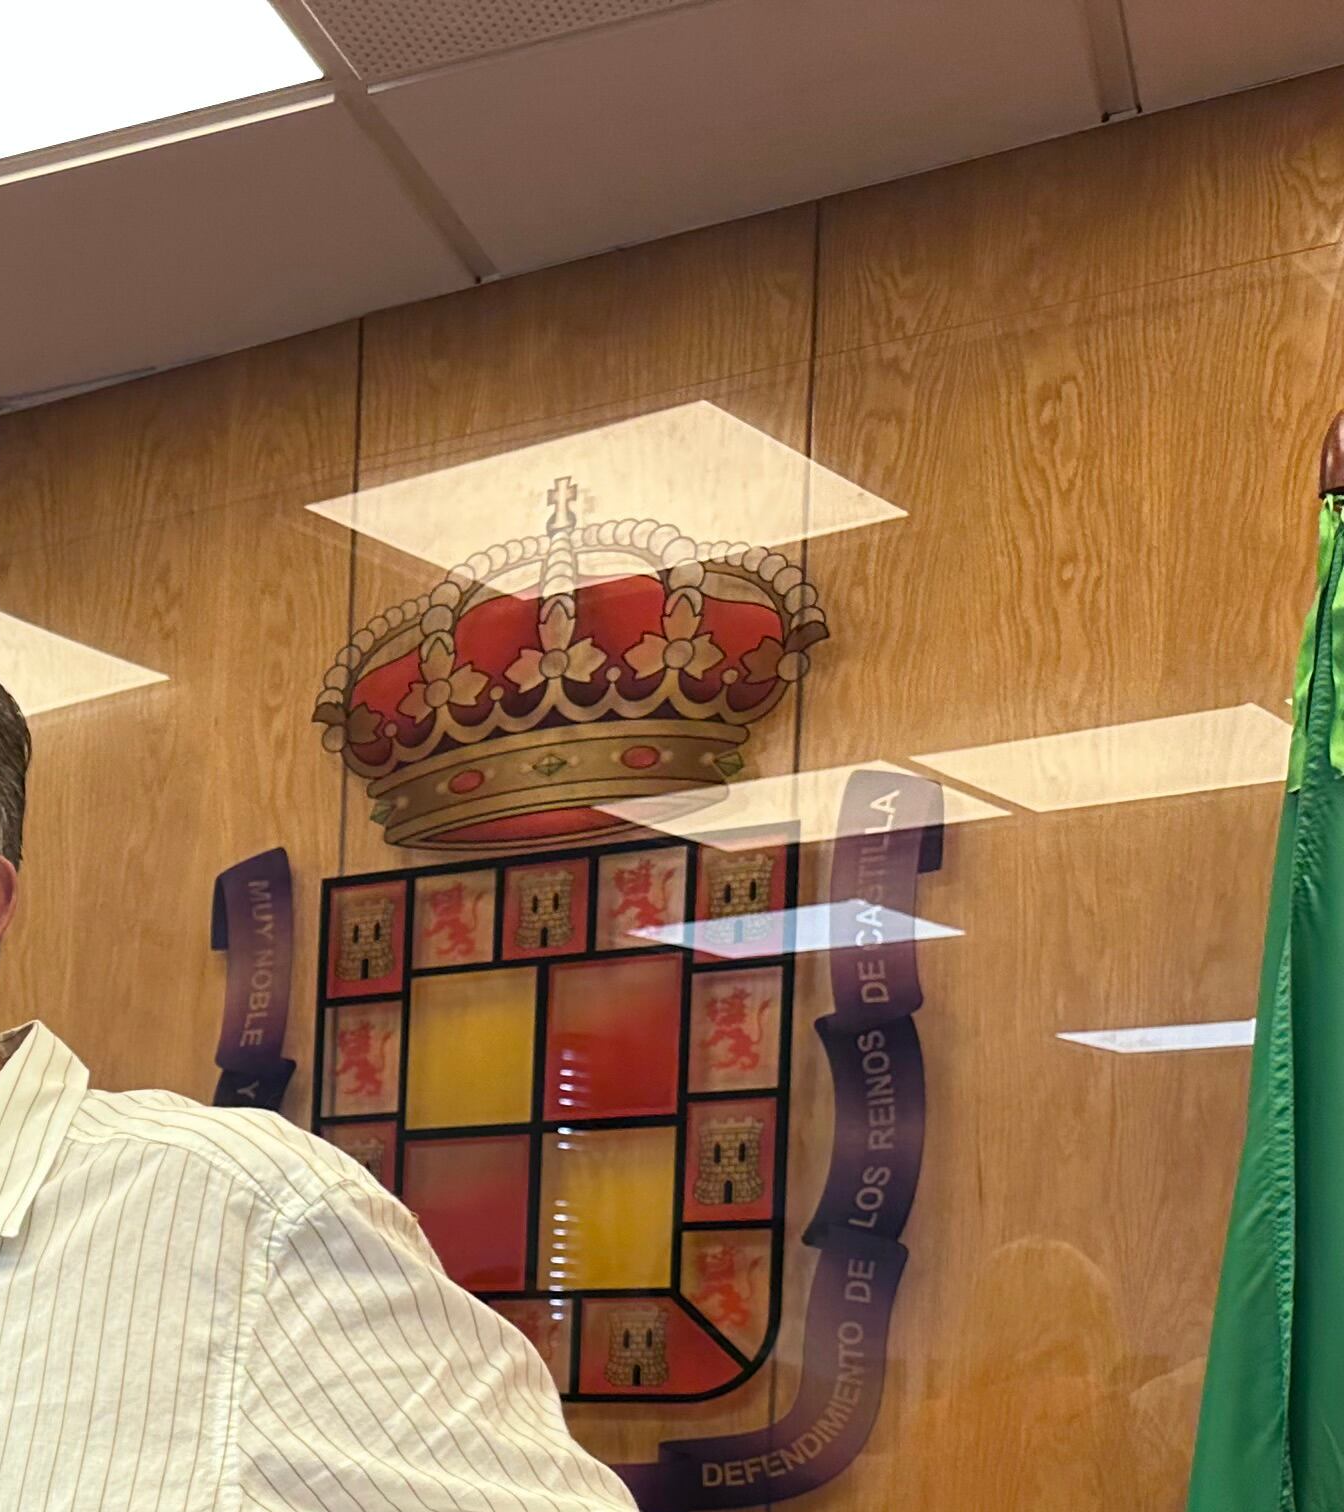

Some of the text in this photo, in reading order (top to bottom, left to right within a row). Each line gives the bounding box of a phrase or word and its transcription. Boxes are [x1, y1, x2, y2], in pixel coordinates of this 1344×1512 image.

[239, 880, 274, 1047] MUY NOBLE
[858, 960, 890, 1004] DE
[857, 1029, 896, 1150] REINOS
[848, 1166, 891, 1229] LOS
[845, 1259, 876, 1304] DE
[701, 1321, 864, 1488] DEFENDIMIENTO
